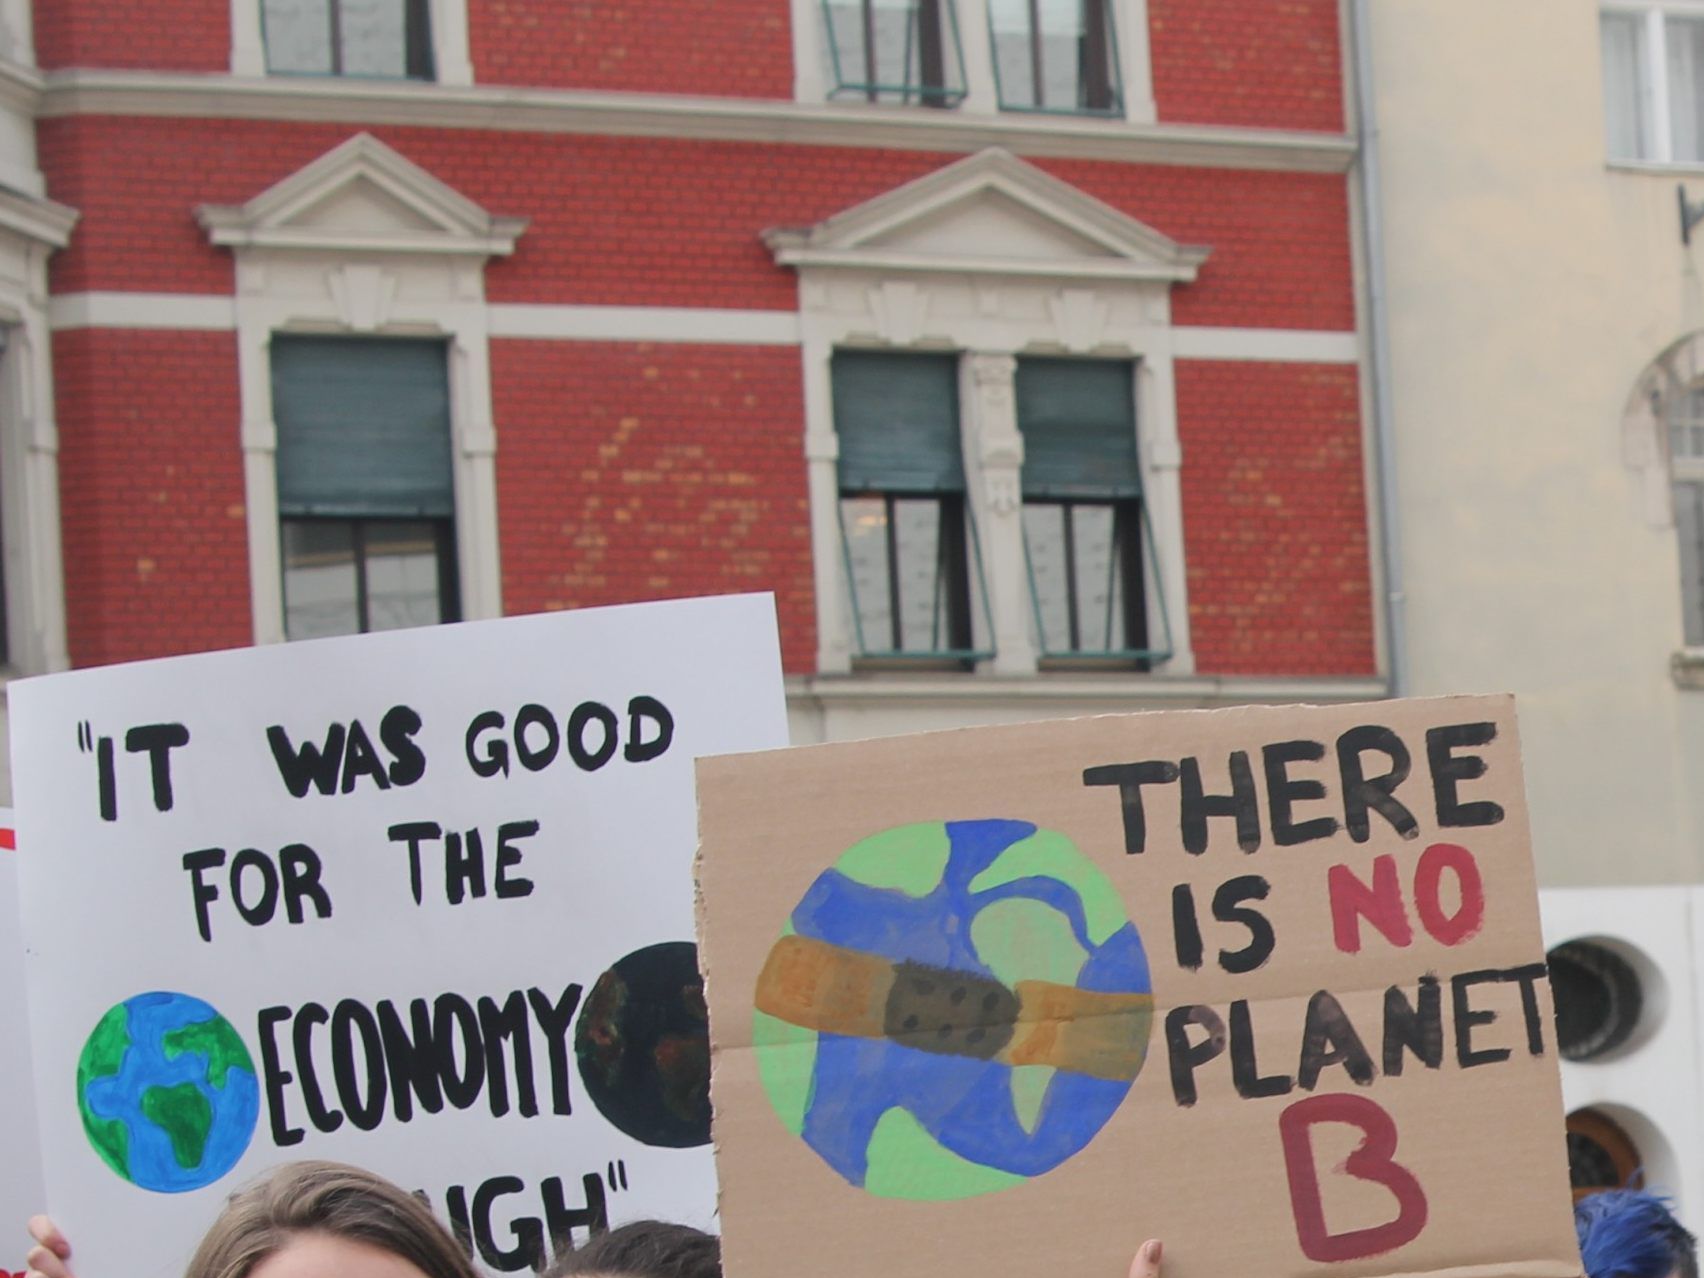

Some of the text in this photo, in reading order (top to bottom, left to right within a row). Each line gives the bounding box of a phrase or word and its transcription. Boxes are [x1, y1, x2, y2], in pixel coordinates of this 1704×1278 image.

[267, 704, 427, 798] WAS
[465, 695, 674, 778] GOOD
[1083, 721, 1505, 856] THERE
[183, 820, 540, 942] FOR THE
[1172, 842, 1484, 975] IS NO
[258, 983, 583, 1147] ECONOMY
[1166, 963, 1549, 1107] PLANET
[1279, 1093, 1429, 1263] B
